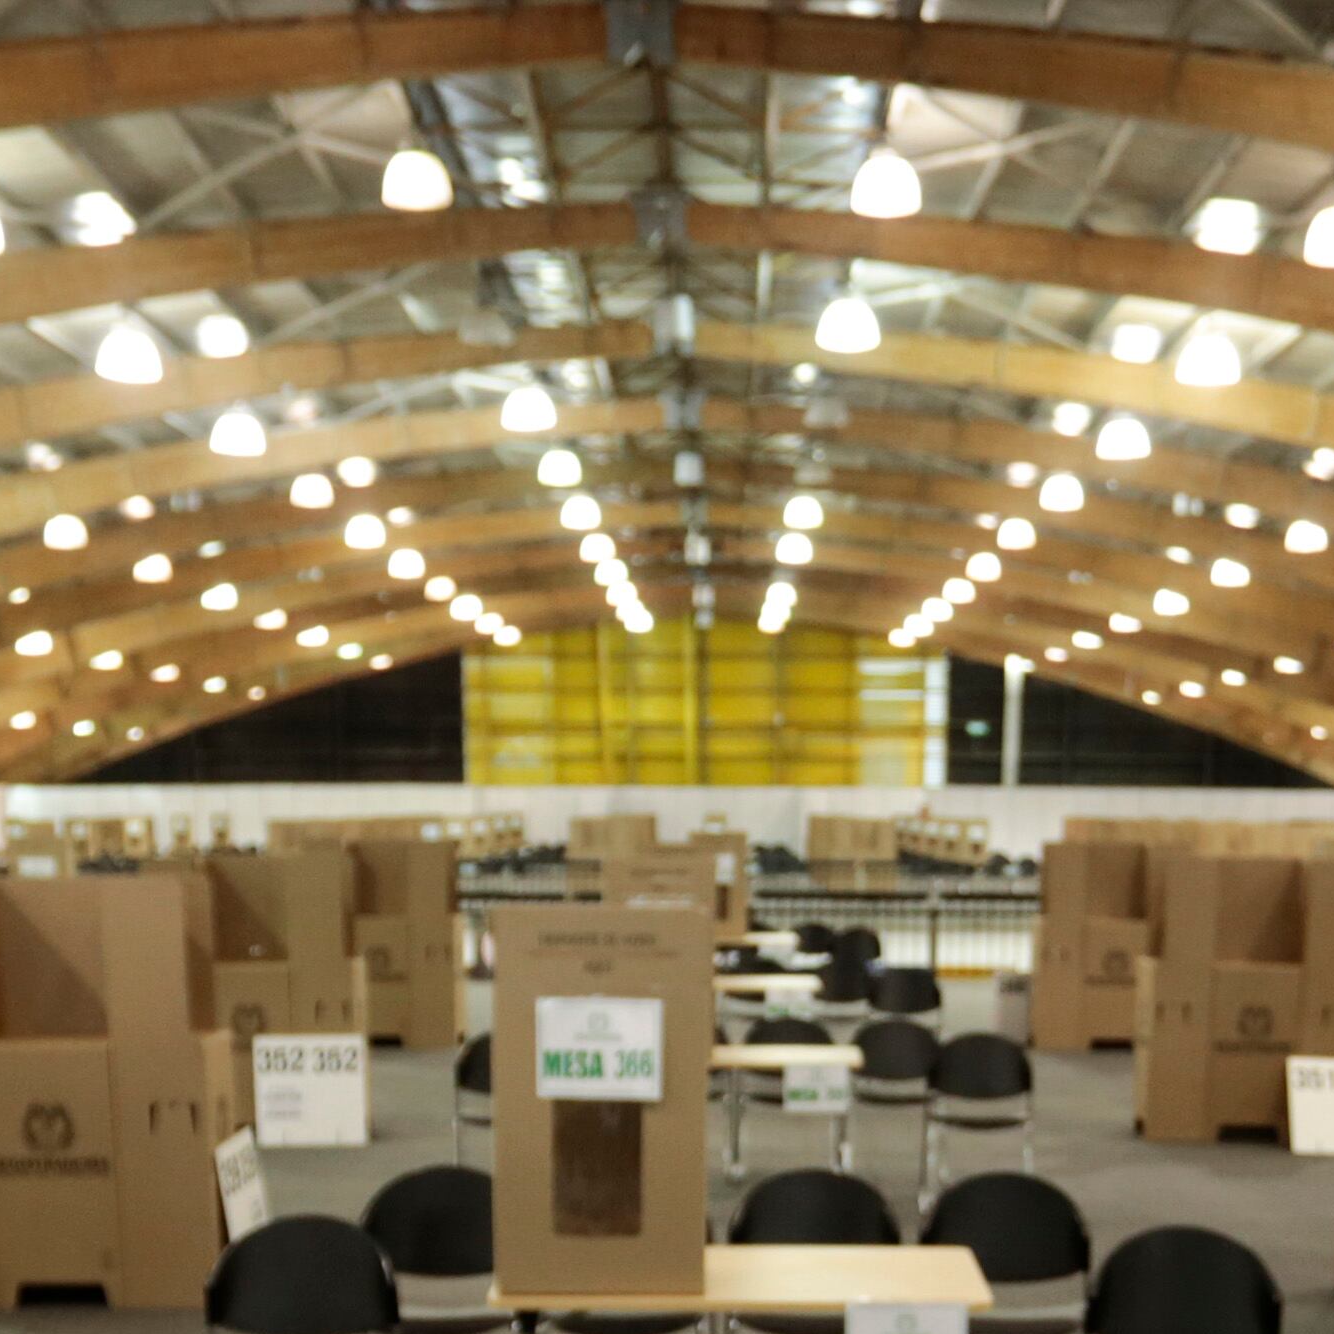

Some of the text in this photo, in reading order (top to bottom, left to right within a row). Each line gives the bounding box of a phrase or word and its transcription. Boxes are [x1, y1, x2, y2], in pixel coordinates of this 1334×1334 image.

[257, 1046, 358, 1073] 352 352
[542, 1049, 655, 1079] MESA 366
